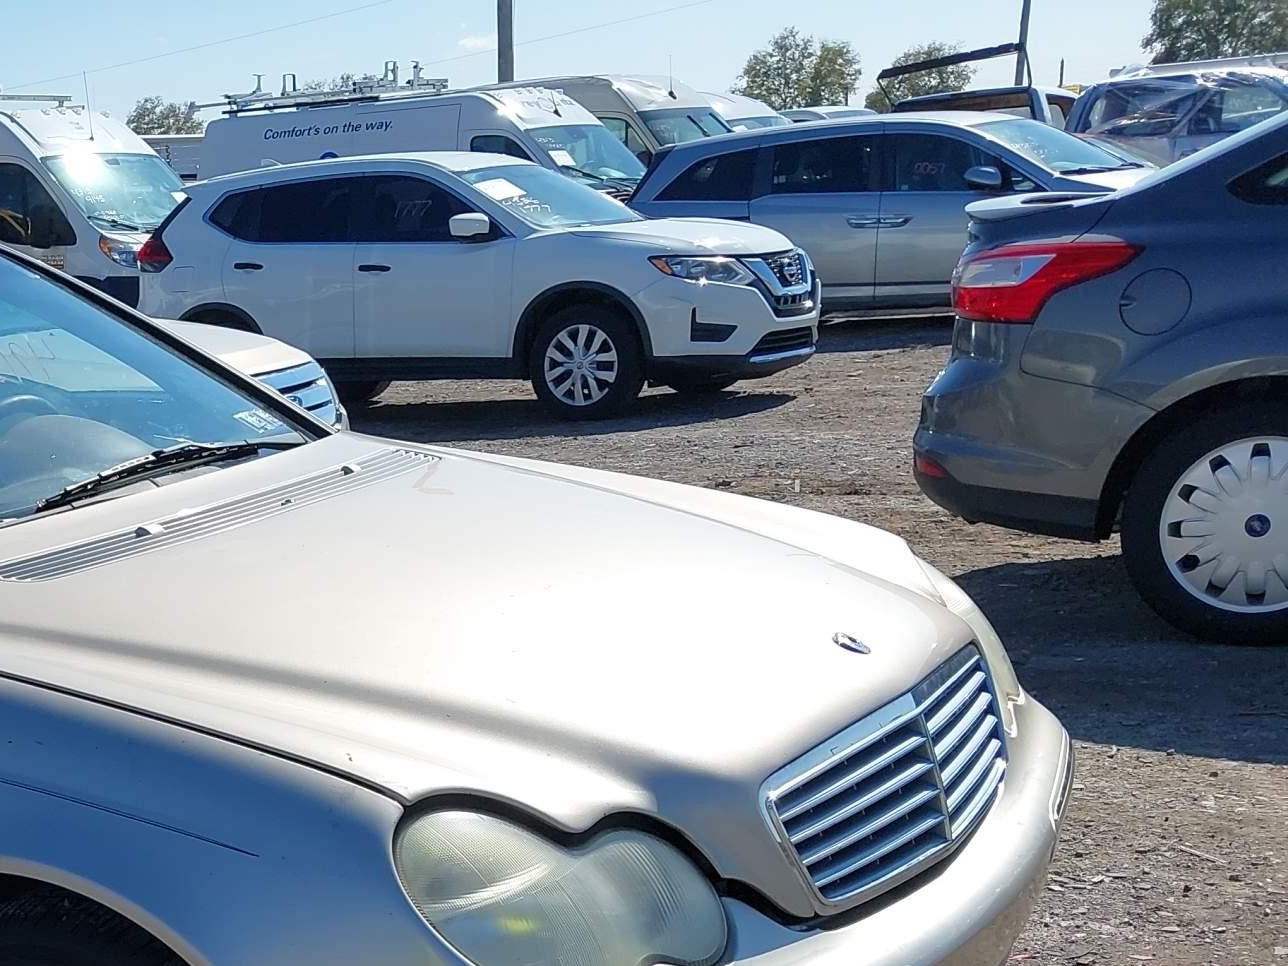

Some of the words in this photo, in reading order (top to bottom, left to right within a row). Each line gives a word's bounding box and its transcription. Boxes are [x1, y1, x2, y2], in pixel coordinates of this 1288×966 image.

[264, 125, 320, 140] Comfort's
[323, 125, 338, 135] on
[342, 121, 362, 133] the
[365, 120, 393, 132] way.
